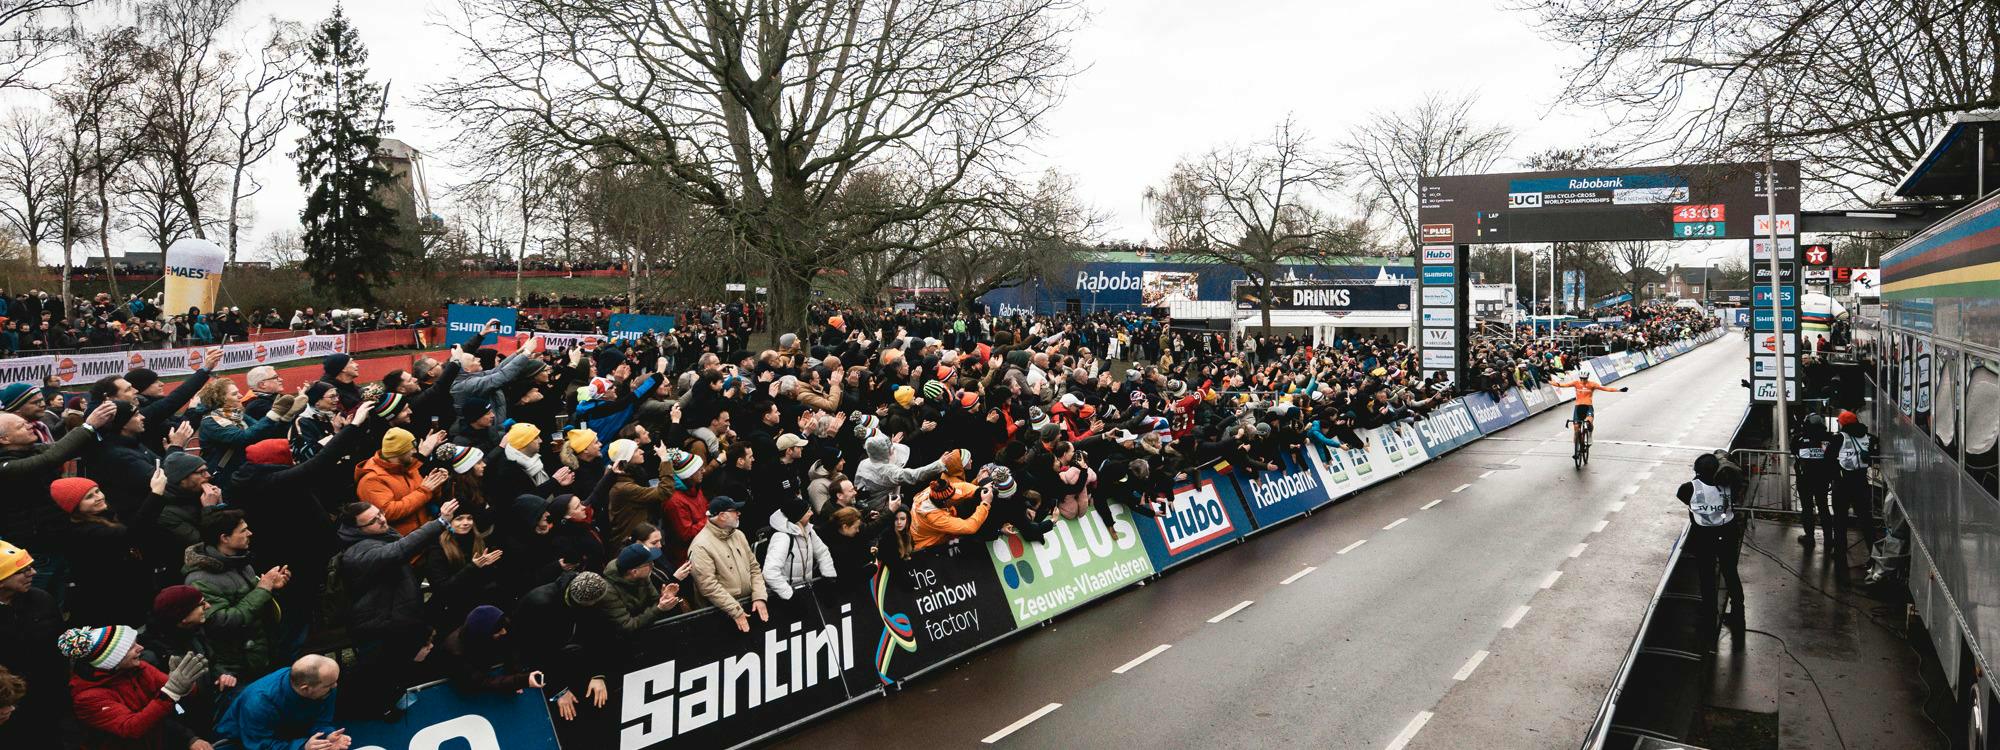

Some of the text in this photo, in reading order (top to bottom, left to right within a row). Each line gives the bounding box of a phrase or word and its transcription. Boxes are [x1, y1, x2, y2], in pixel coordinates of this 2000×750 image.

[1568, 177, 1623, 189] Rabobank
[1514, 194, 1540, 205] UCI
[1429, 227, 1451, 235] PLUS
[1683, 224, 1716, 236] 8:28
[1426, 250, 1451, 259] Hubo
[171, 265, 205, 279] MAES
[1076, 270, 1143, 291] Raboba
[1293, 288, 1350, 307] DRINKS
[1763, 292, 1791, 301] MES
[1430, 330, 1448, 339] WZ
[269, 344, 295, 357] MMMM
[308, 340, 333, 352] MMMM
[150, 356, 185, 370] MMMM
[223, 350, 253, 364] MMMM
[81, 360, 124, 376] MMMM
[1472, 400, 1503, 424] Rabobank
[1419, 406, 1475, 449] SHIMANO
[1249, 467, 1317, 509] Rabobank
[1163, 494, 1223, 544] Hubo
[1031, 503, 1136, 578] PLUS
[1014, 554, 1149, 621] Zeeuws-Vlaanderen
[916, 580, 977, 615] rainbow
[925, 608, 980, 643] factory
[620, 602, 854, 750] Santini
